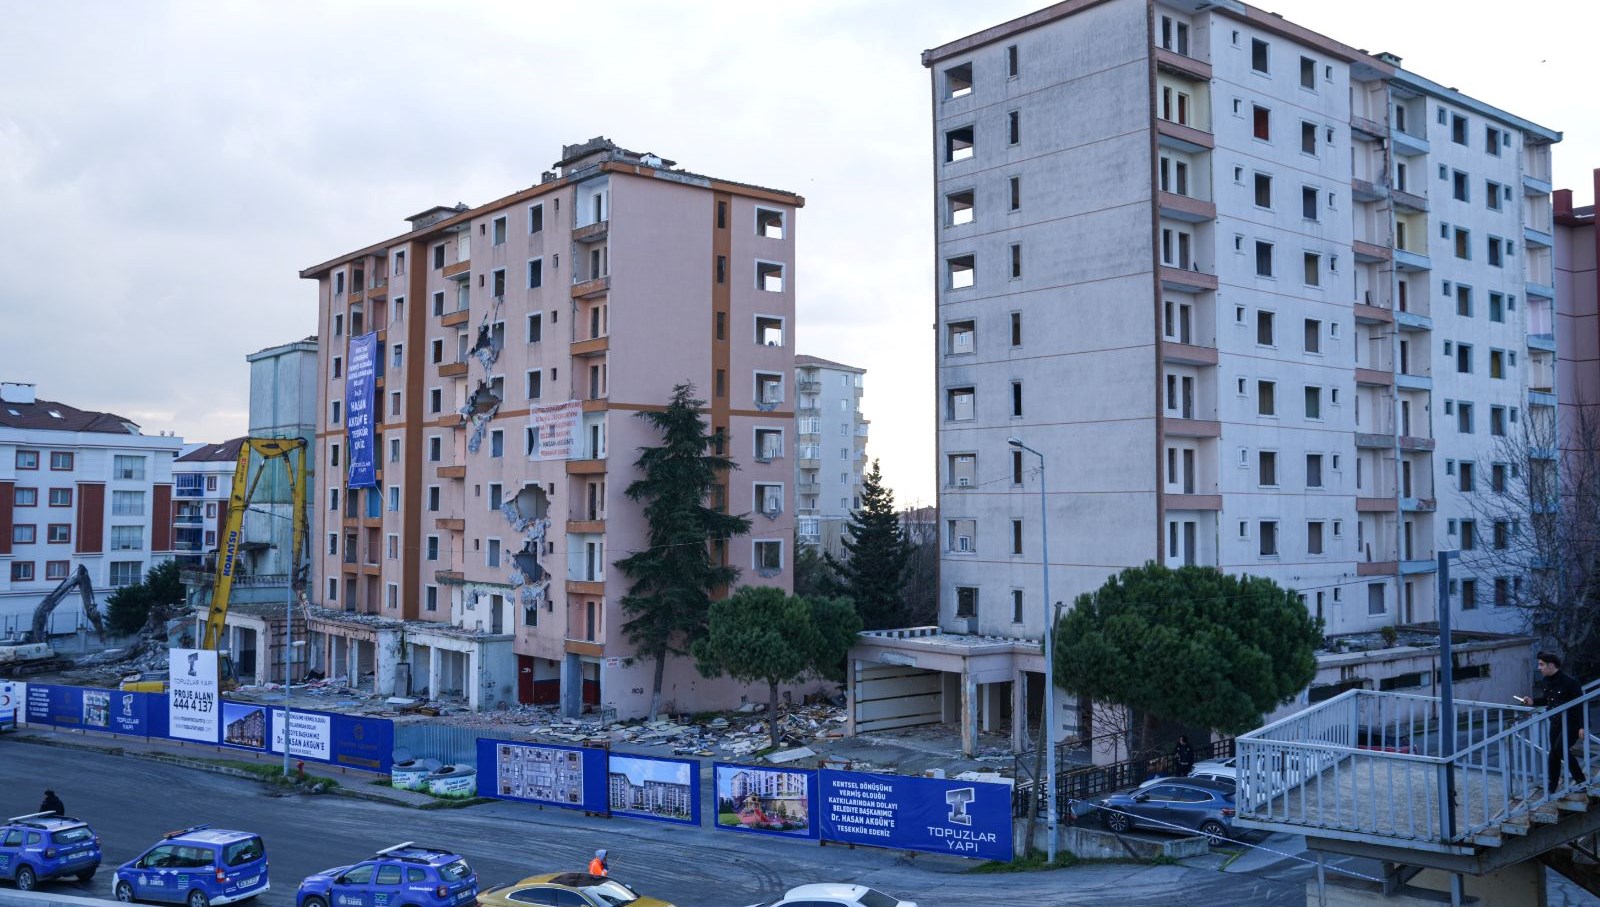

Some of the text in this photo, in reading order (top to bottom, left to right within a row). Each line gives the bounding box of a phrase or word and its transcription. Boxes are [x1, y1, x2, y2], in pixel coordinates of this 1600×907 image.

[223, 530, 237, 576] KOMATSU
[174, 690, 213, 701] PROJE ALANI
[174, 698, 212, 713] 444 4 137
[833, 781, 892, 792] KENTSEL DÖNÜŞÜME
[840, 790, 886, 800] VERMİŞ OLDUĞU
[829, 797, 898, 810] KATKILARINDAN DOLAYI
[859, 807, 893, 817] BAŞKANIMIZ
[831, 813, 894, 827] Dr. HASAN AKGÜN'E
[837, 825, 890, 837] TEŞEKKÜR EDERİZ
[927, 827, 996, 842] TOPUZLAR
[947, 840, 978, 852] YAPI
